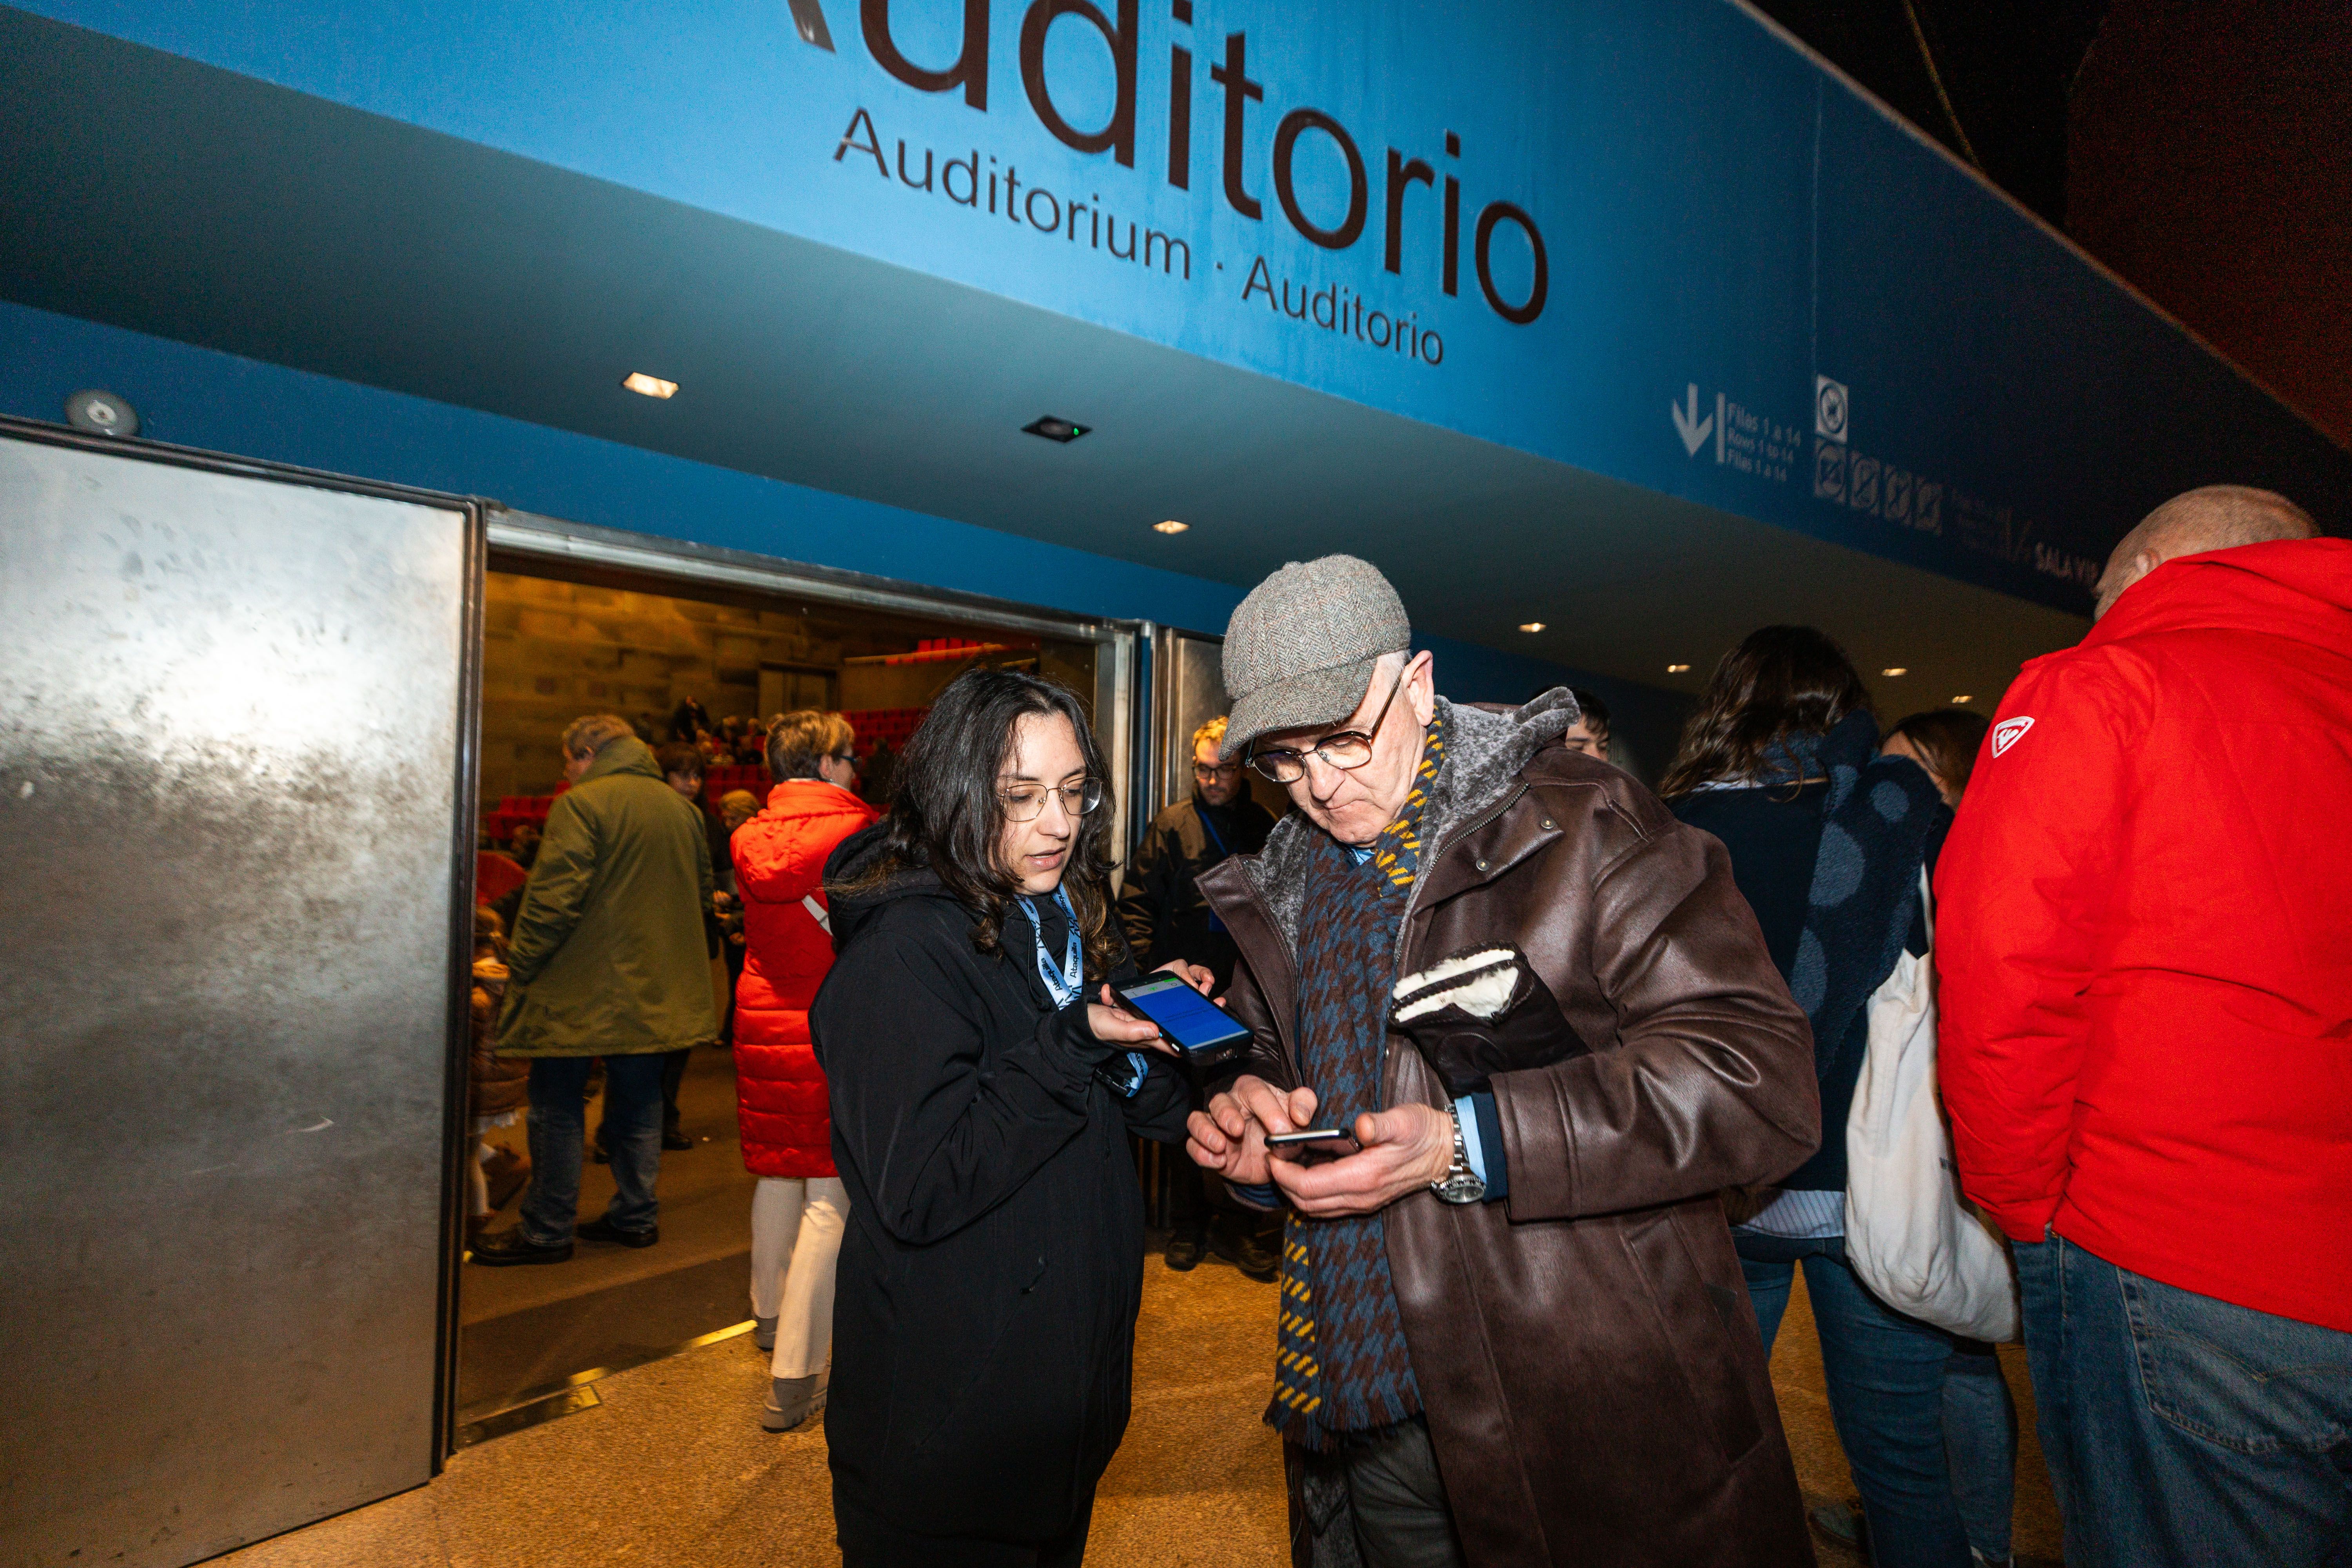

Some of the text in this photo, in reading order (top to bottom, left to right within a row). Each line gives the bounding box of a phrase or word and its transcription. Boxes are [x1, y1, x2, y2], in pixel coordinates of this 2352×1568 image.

[786, 0, 1549, 325] uditorio
[833, 106, 1190, 280] Auditorium
[1241, 255, 1444, 366] Auditorio
[1728, 426, 1755, 453] Rows
[1763, 417, 1769, 437] 1
[1786, 426, 1801, 447] 14
[1774, 465, 1787, 482] 14
[1041, 957, 1063, 991] Ataquilla
[1070, 942, 1079, 978] Ataquilla
